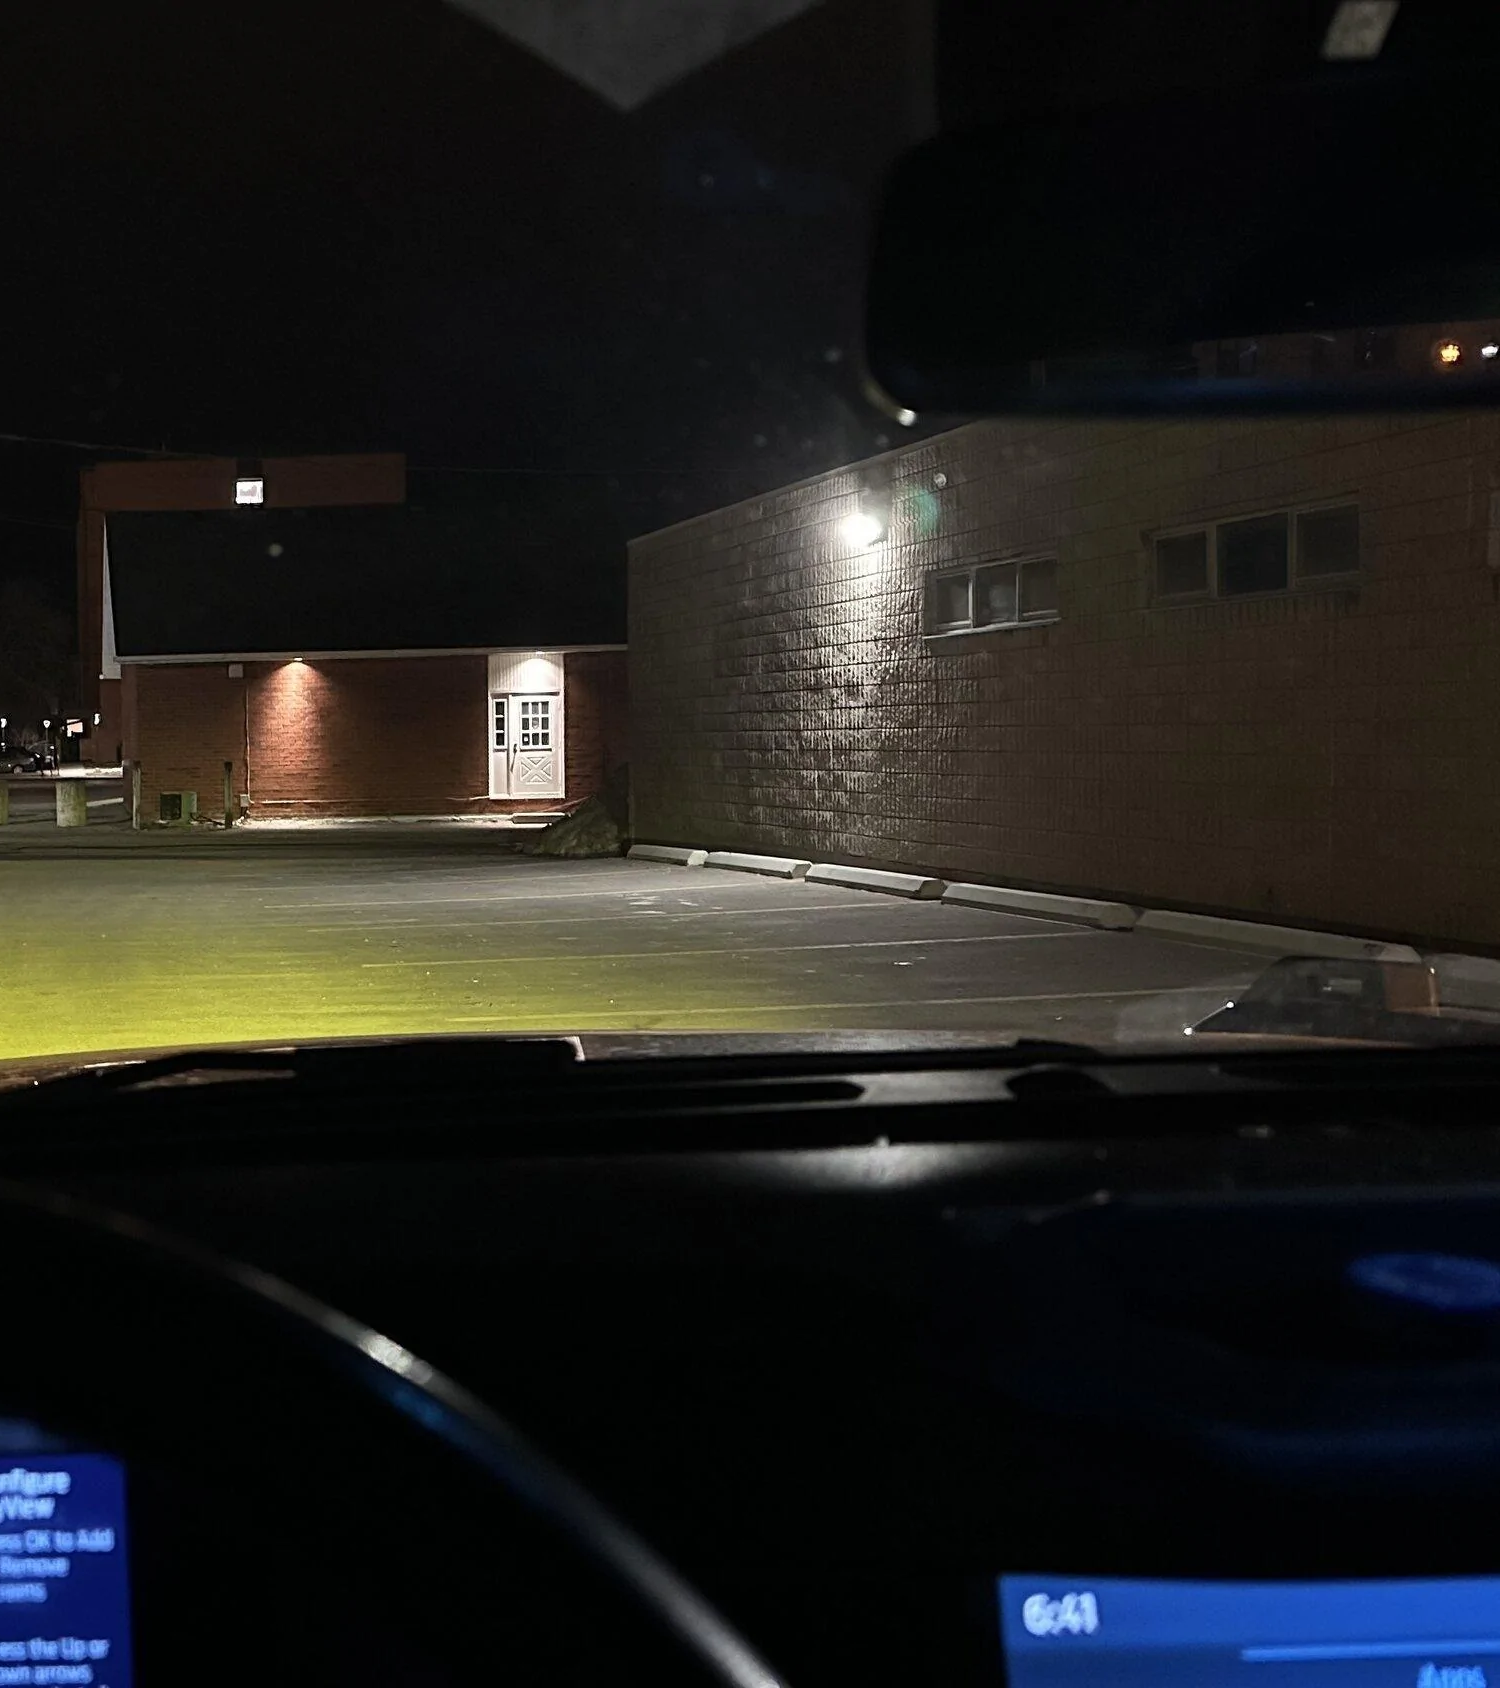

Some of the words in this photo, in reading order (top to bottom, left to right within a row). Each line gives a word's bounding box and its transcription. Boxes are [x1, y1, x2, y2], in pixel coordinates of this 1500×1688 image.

[24, 1529, 52, 1554] OK
[53, 1531, 75, 1553] to
[76, 1528, 115, 1552] Add
[1022, 1592, 1099, 1636] 6:41
[28, 1637, 59, 1660] the
[60, 1637, 87, 1661] Up
[88, 1638, 110, 1660] or
[33, 1664, 94, 1686] arrows
